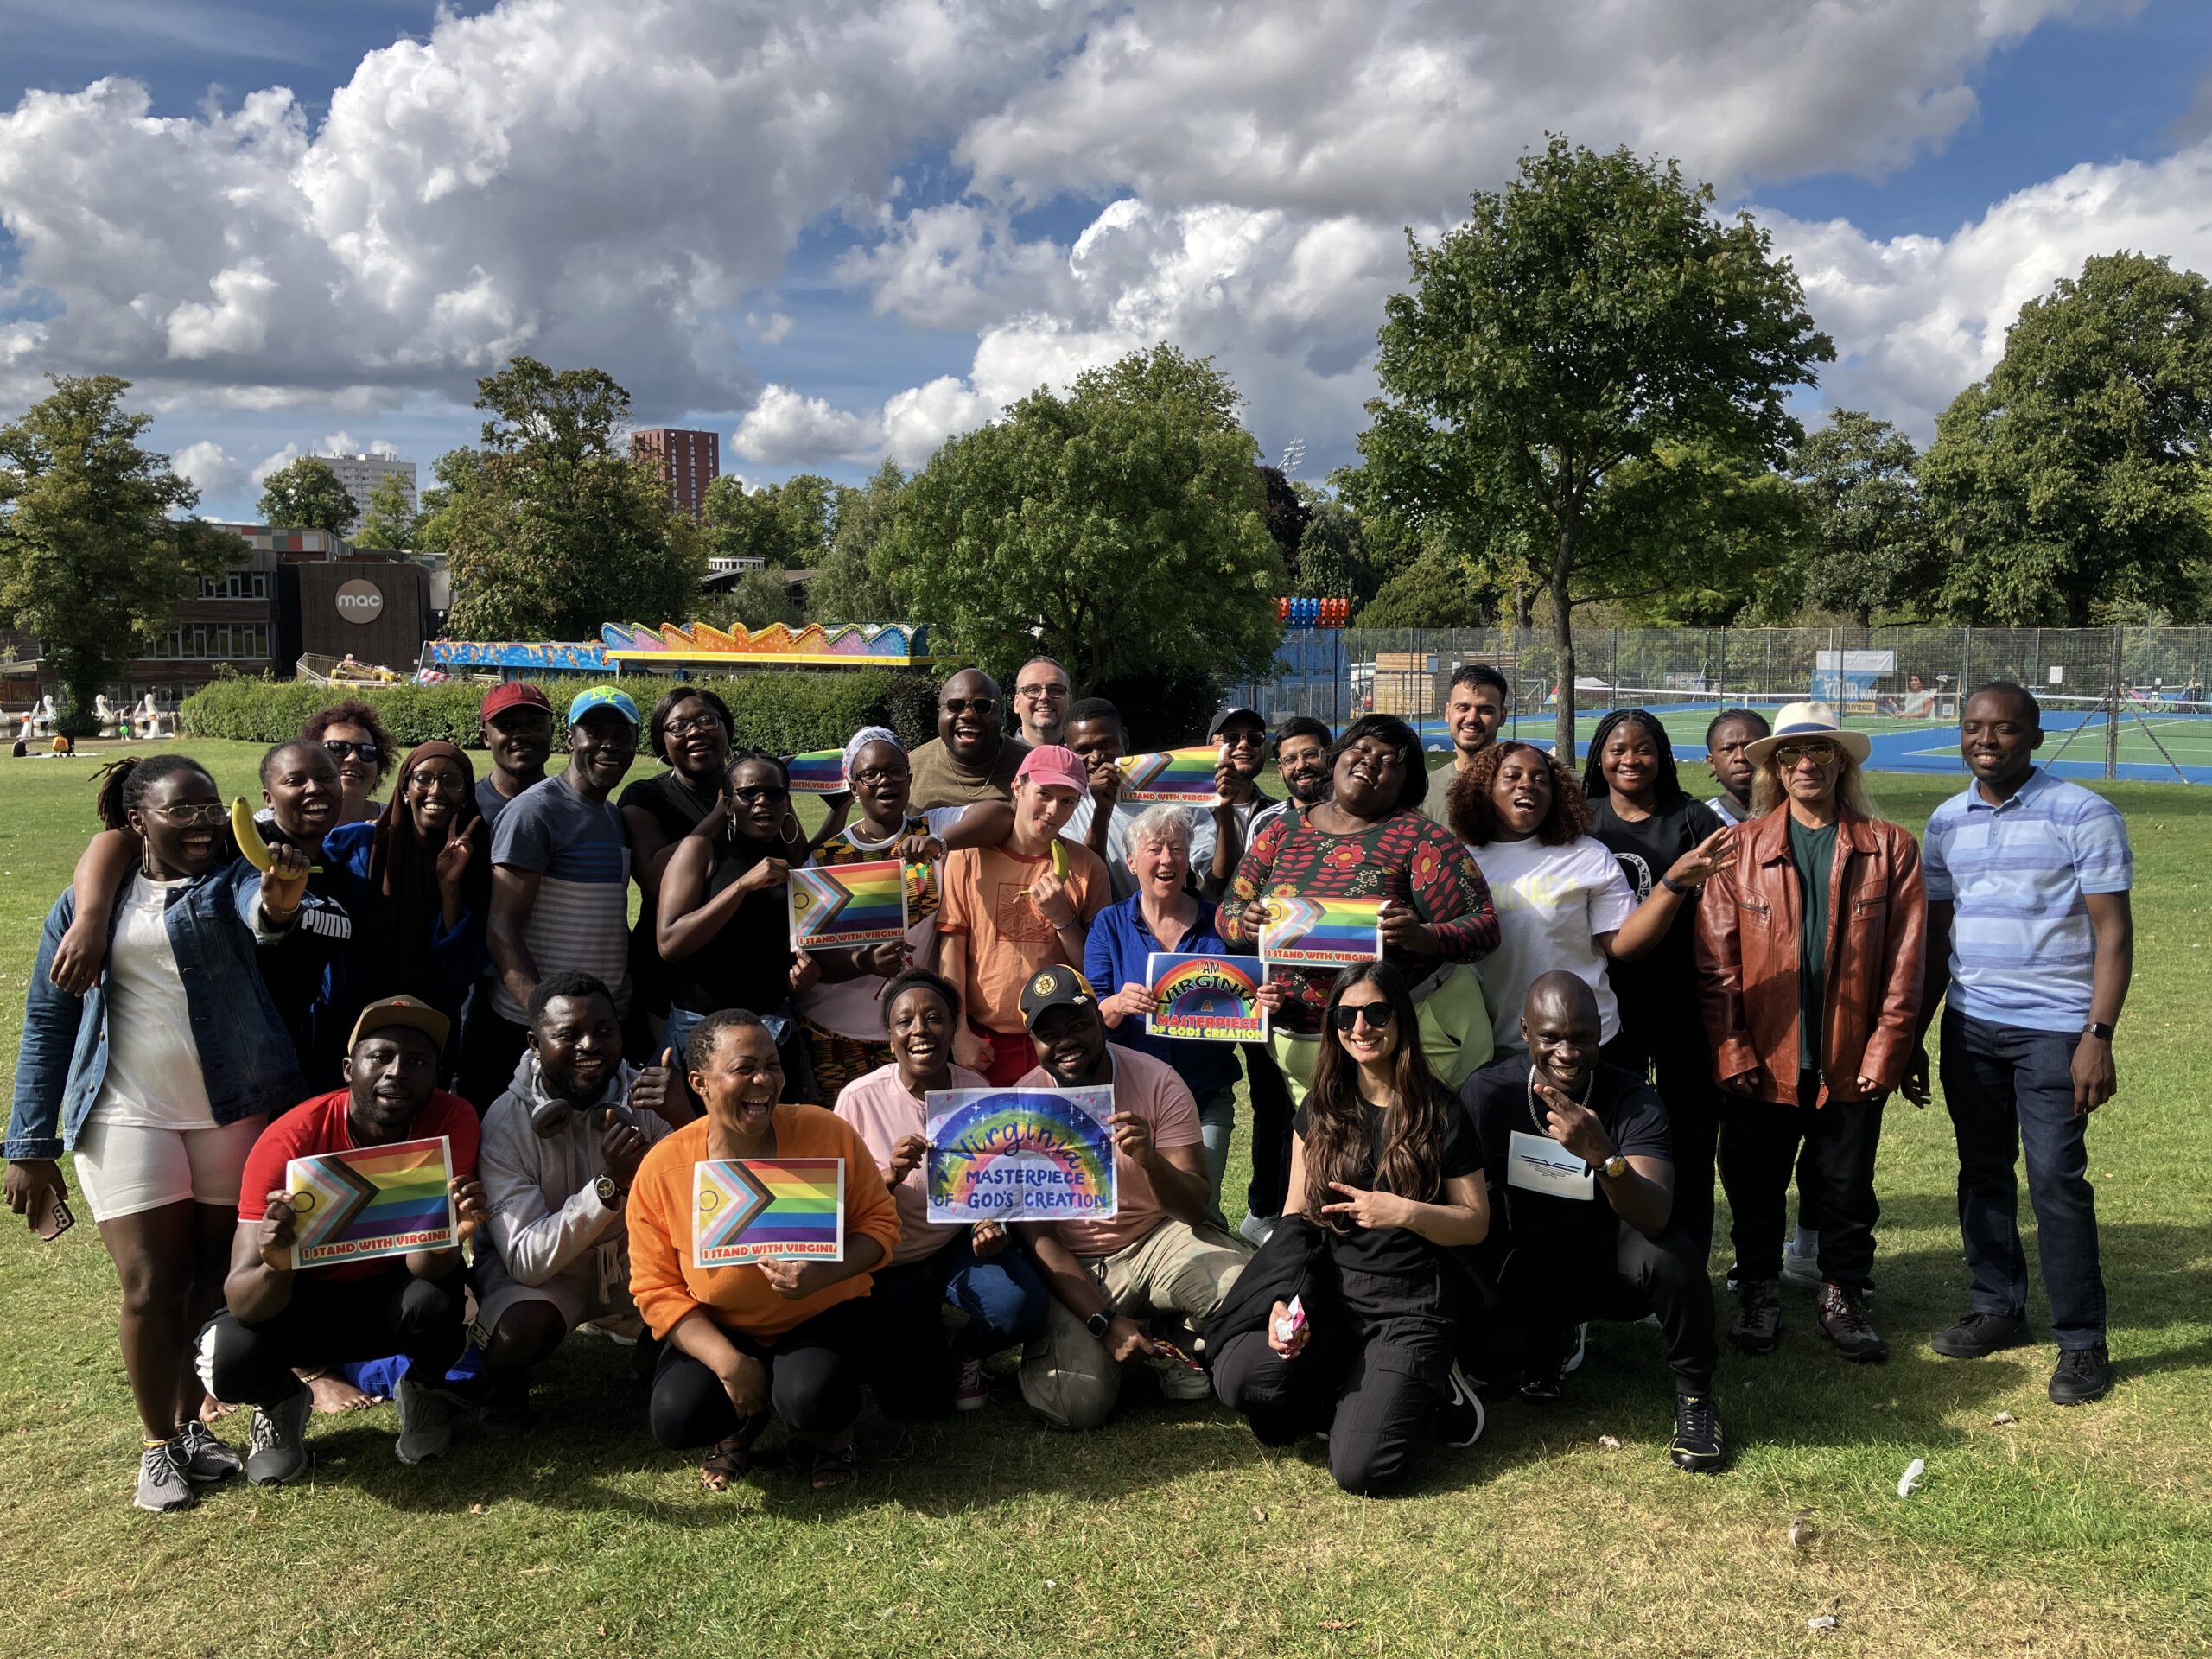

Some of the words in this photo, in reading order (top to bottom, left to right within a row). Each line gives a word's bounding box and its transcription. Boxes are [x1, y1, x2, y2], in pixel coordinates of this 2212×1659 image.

[338, 594, 381, 607] mac
[1824, 683, 1859, 699] YOUR
[1859, 689, 1878, 700] WAY
[1128, 791, 1155, 800] STAND
[301, 908, 352, 940] PUMA
[799, 937, 804, 945] I
[805, 934, 836, 944] STAND
[838, 932, 863, 942] WITH
[1273, 950, 1304, 959] STAND
[1306, 951, 1332, 960] WITH
[1197, 962, 1201, 972] I
[1202, 960, 1220, 974] AM
[1158, 975, 1258, 1011] VIRGINIA
[1201, 1000, 1214, 1012] A
[1157, 1014, 1259, 1030] MASTERPIECE
[1152, 1024, 1166, 1034] OF
[1167, 1026, 1201, 1037] GODS
[1204, 1027, 1262, 1039] CREATION
[949, 1118, 1082, 1170] Virginia
[937, 1169, 949, 1183] A
[966, 1168, 1086, 1187] MASTERPIECE
[934, 1193, 954, 1207] OF
[967, 1191, 1014, 1208] GOD'S
[1024, 1192, 1107, 1209] CREATION
[304, 1248, 309, 1259] I
[313, 1243, 356, 1258] STAND
[359, 1238, 393, 1252] WITH
[704, 1249, 709, 1259] I
[711, 1247, 749, 1259] STAND
[751, 1243, 783, 1255] WITH
